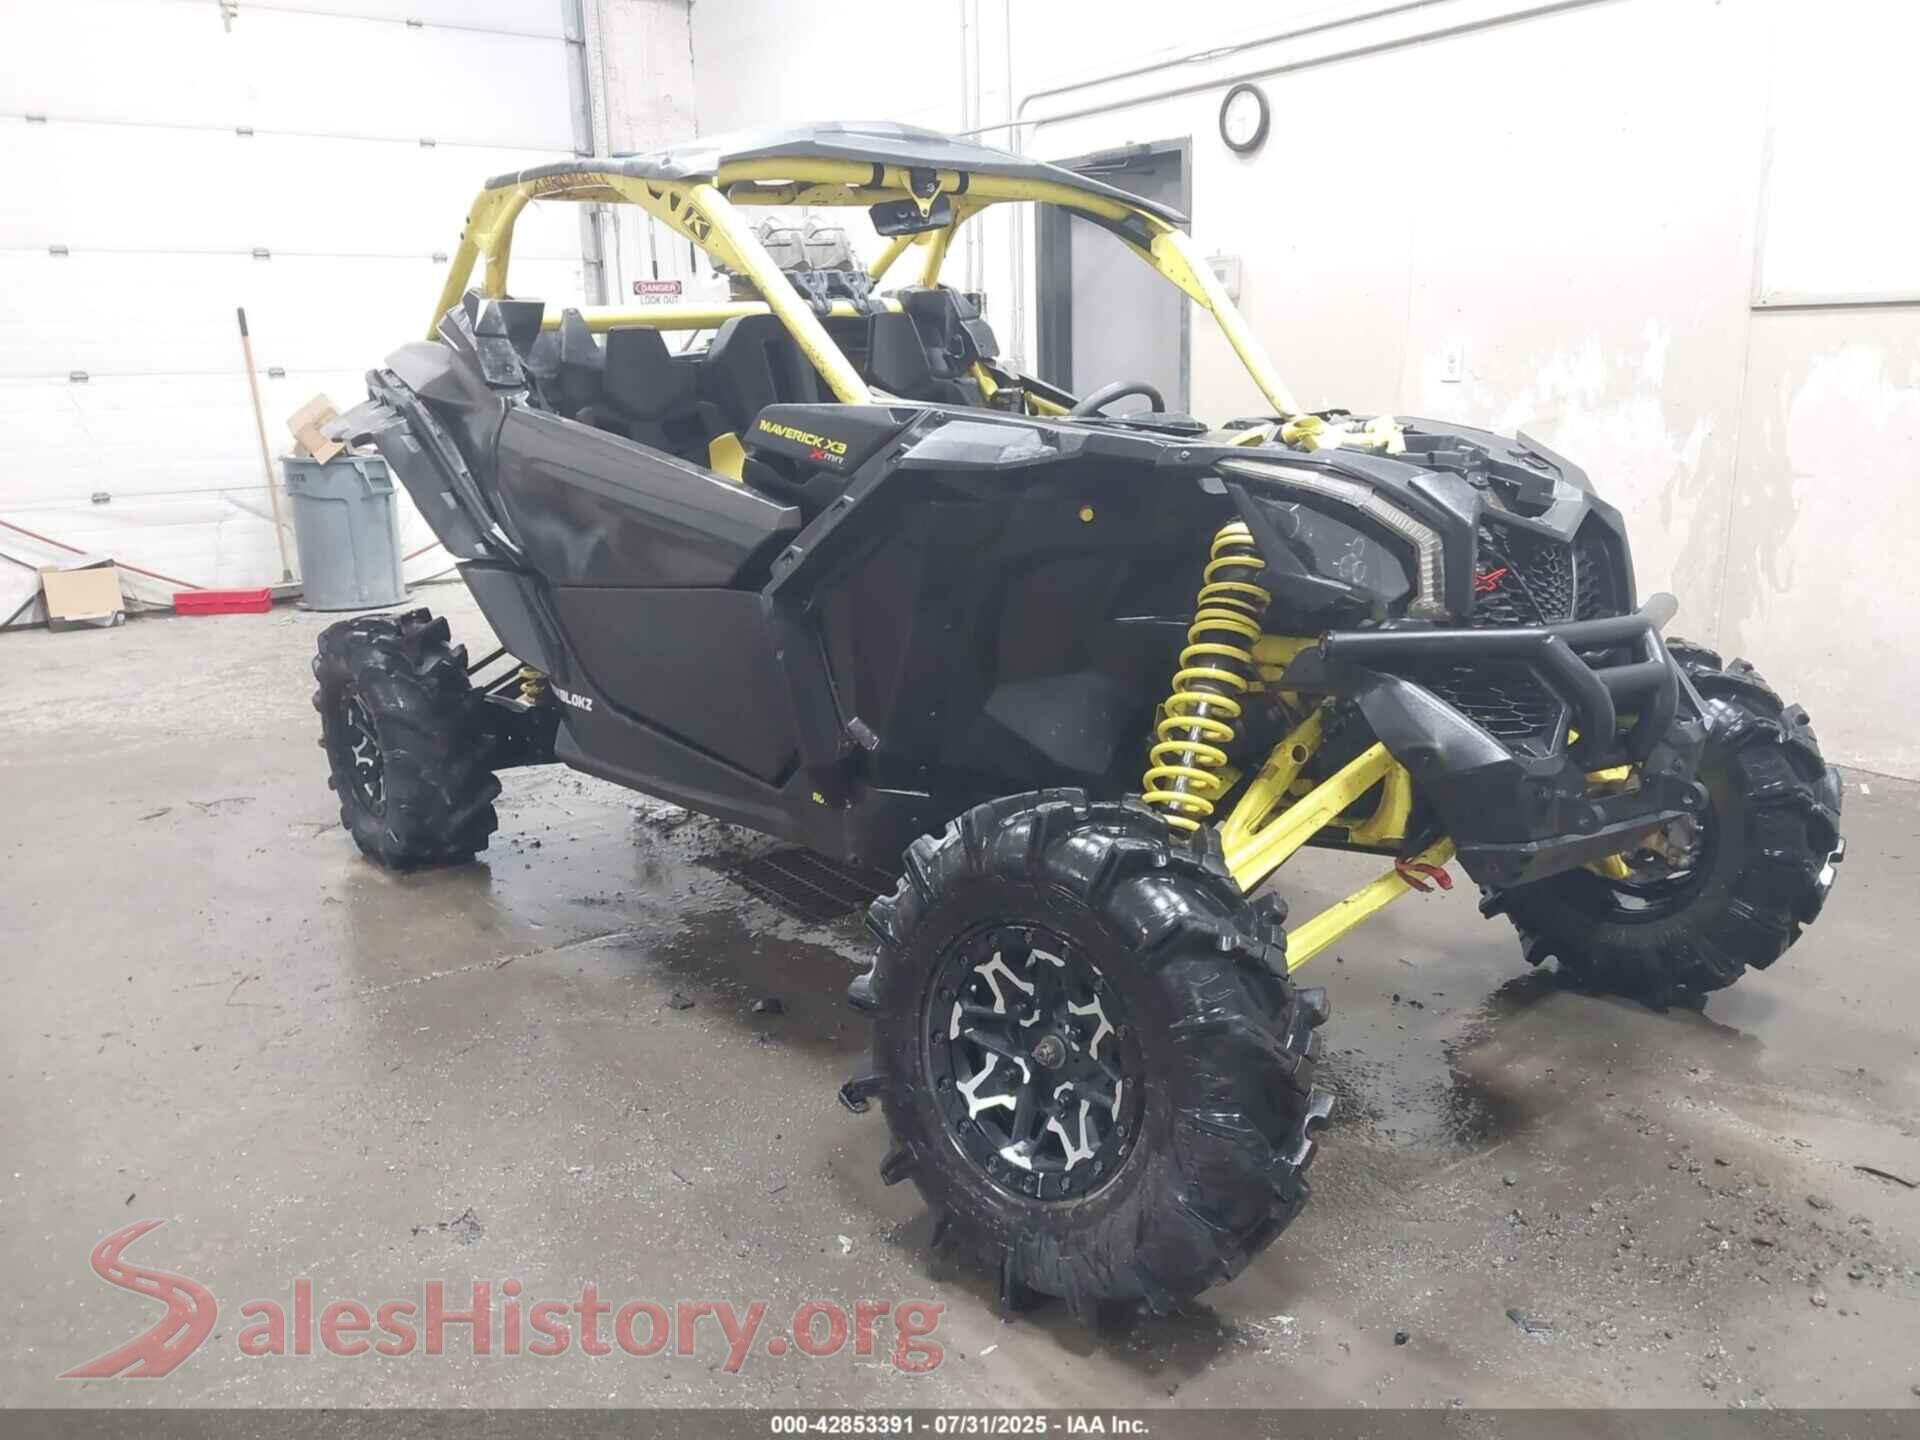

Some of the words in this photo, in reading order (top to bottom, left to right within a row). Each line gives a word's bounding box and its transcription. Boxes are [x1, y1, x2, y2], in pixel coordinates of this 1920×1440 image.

[639, 283, 677, 293] DANGER
[640, 295, 661, 305] LOOK
[663, 295, 679, 305] OUT
[759, 419, 825, 448] MAVERICK
[824, 439, 848, 455] X3
